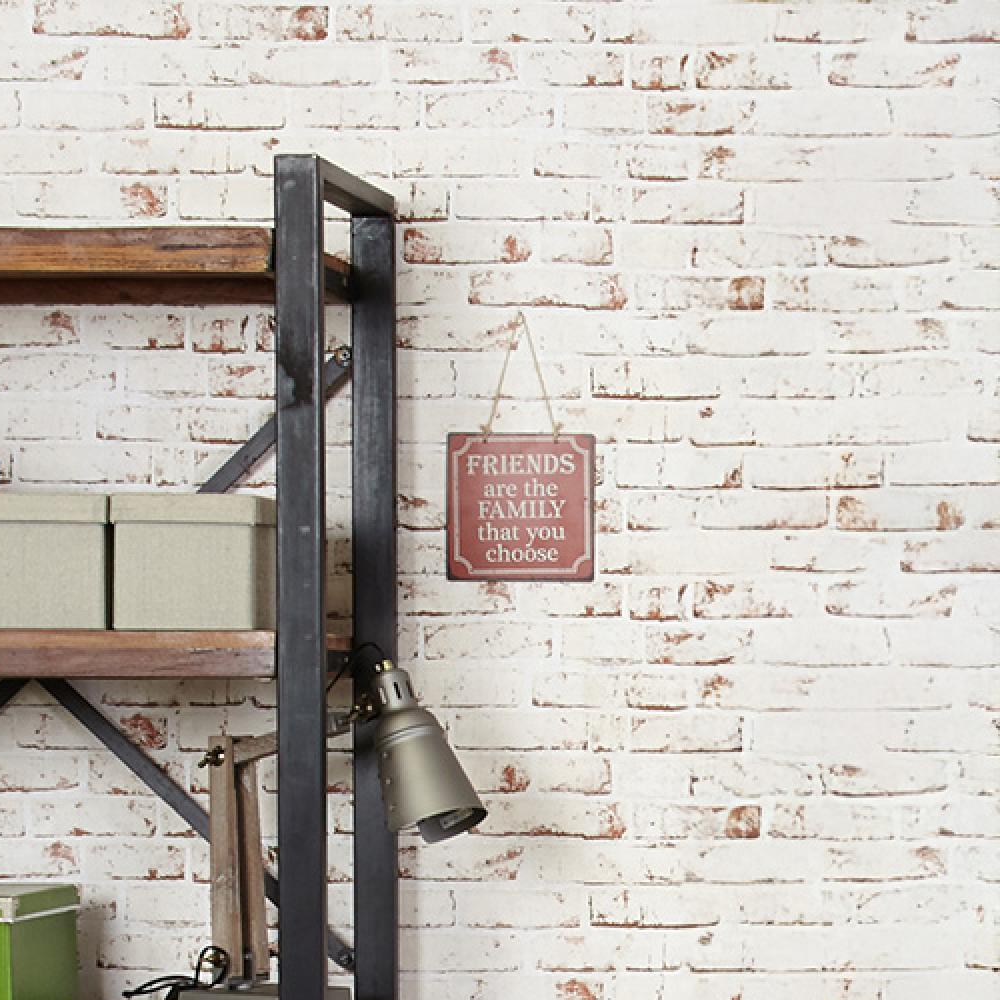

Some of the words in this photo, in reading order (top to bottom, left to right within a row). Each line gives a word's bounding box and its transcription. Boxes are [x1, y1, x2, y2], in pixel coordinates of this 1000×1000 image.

[466, 453, 577, 475] FRIENDS
[483, 481, 517, 497] are
[524, 478, 559, 497] the
[477, 500, 567, 519] FAMILY
[477, 522, 520, 541] that
[526, 526, 565, 546] you
[485, 544, 559, 563] choose
